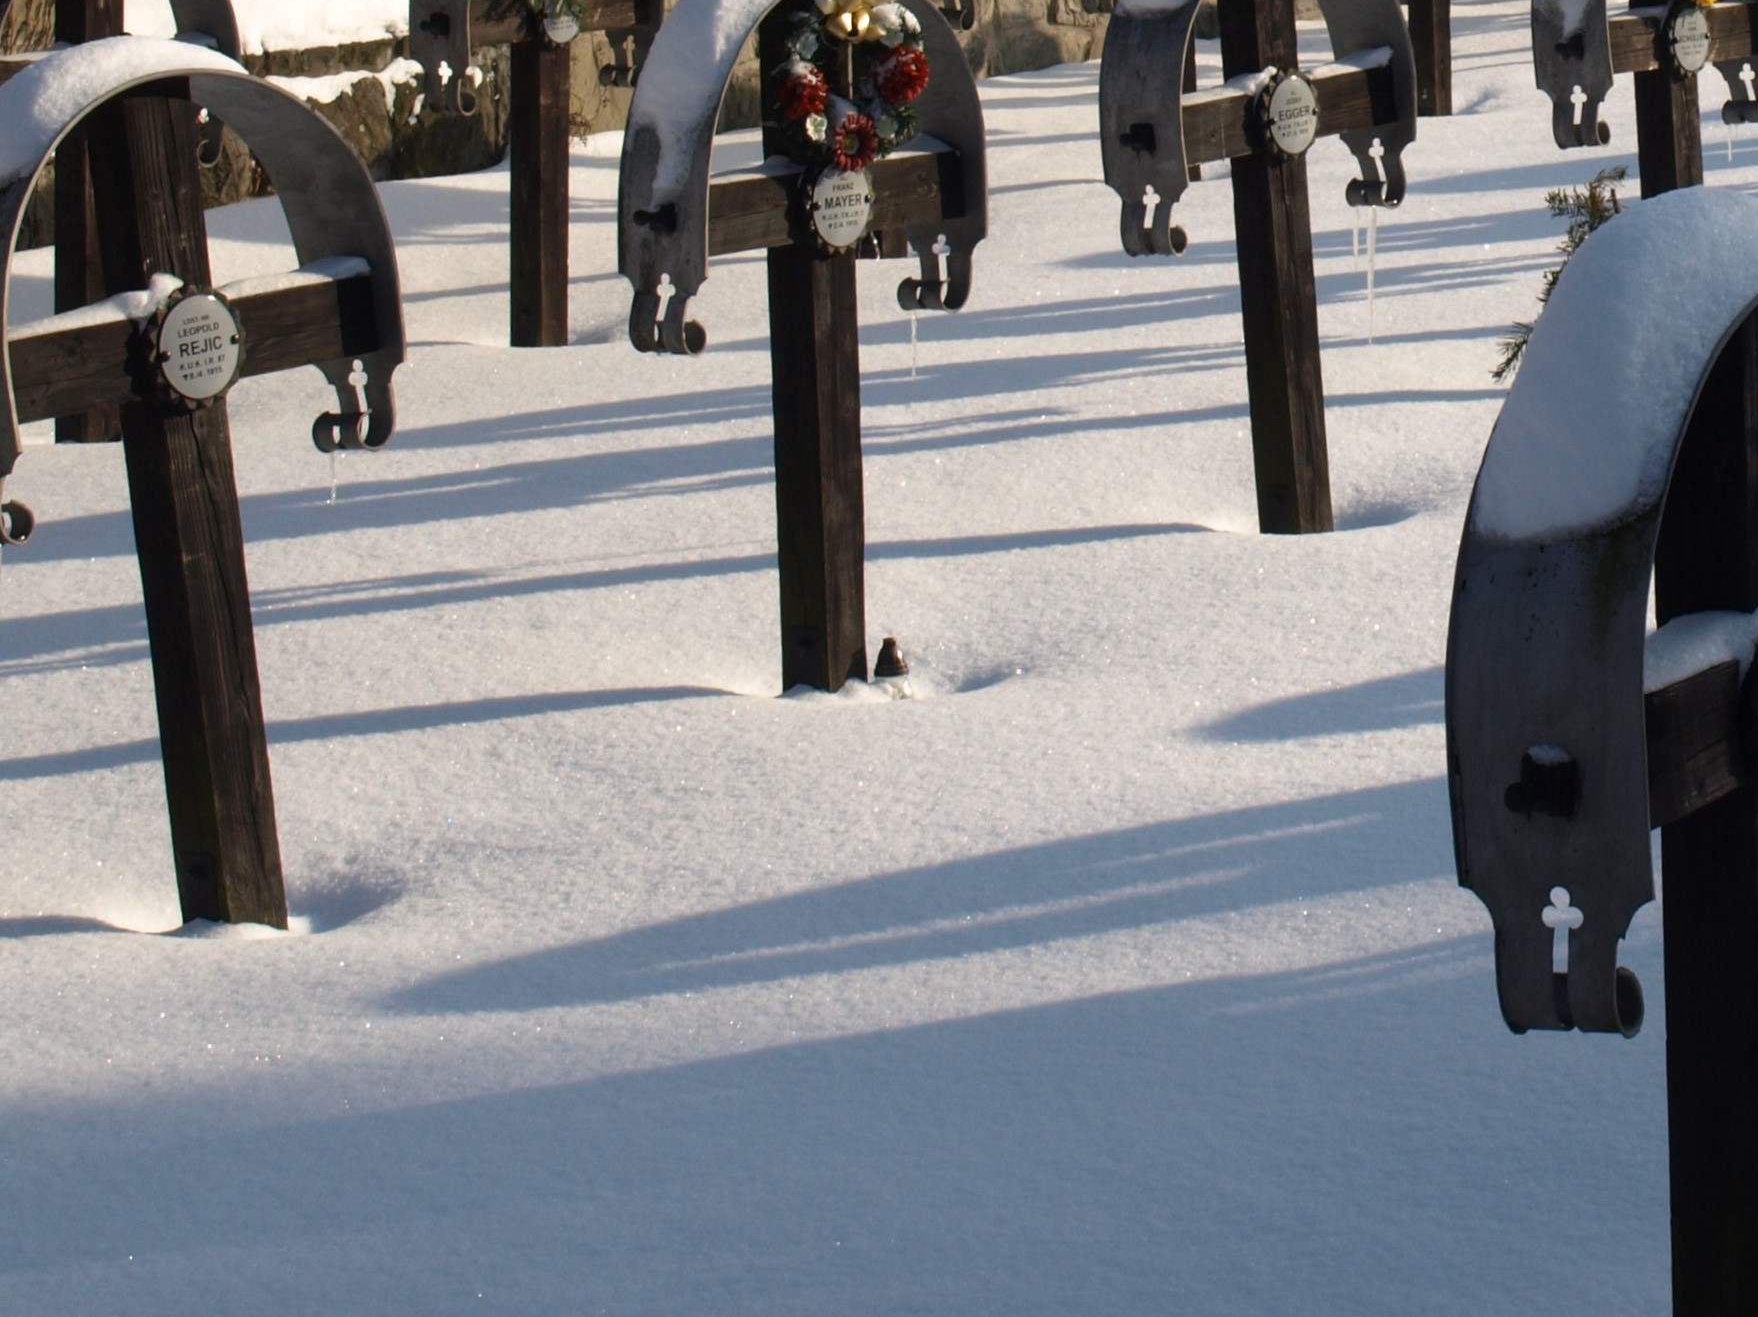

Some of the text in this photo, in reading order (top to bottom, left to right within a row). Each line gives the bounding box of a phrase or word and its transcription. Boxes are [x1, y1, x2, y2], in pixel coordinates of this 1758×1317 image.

[1278, 105, 1310, 121] EGGER
[824, 193, 862, 210] MAYER
[177, 322, 220, 338] LEOPOLD
[179, 336, 222, 358] REJIC
